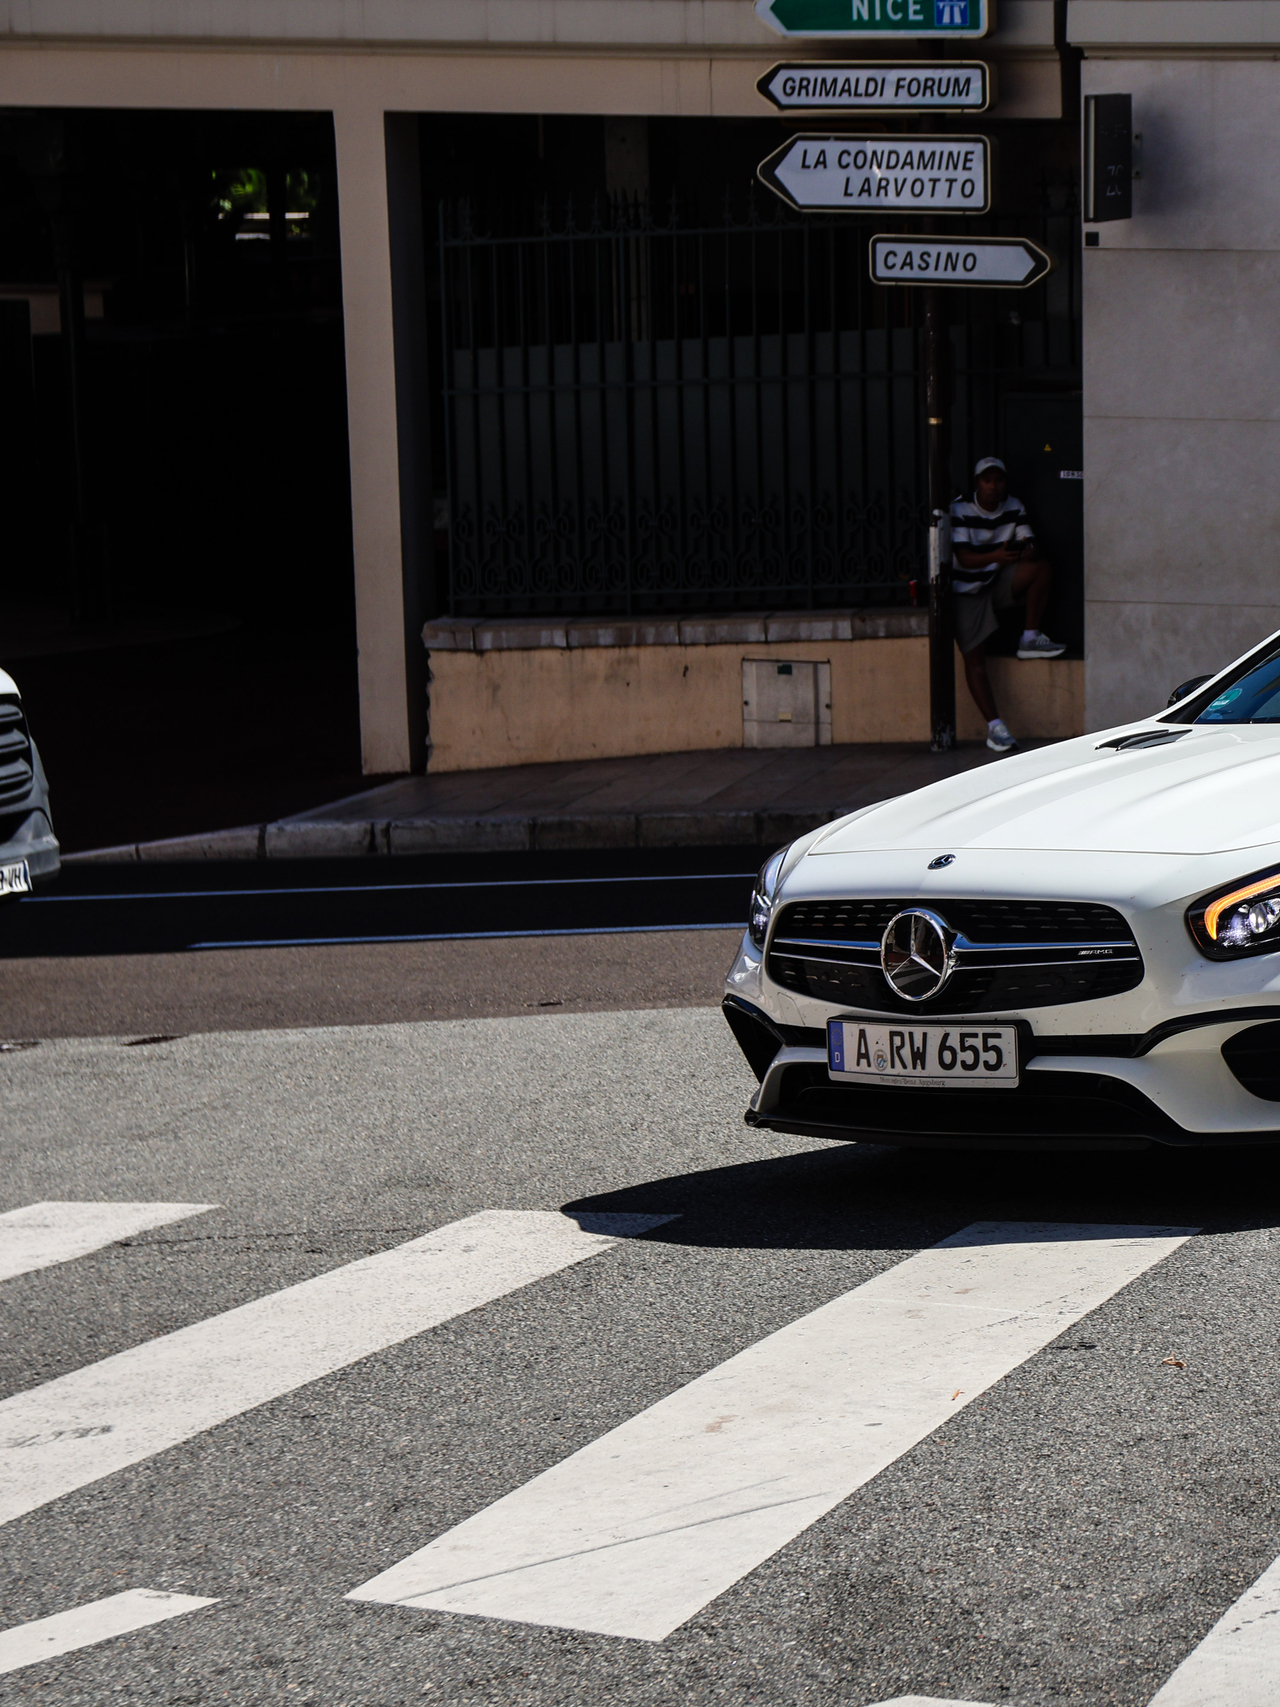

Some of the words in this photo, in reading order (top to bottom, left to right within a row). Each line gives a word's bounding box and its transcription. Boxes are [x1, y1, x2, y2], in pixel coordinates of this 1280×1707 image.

[851, 0, 924, 21] NICE
[782, 77, 886, 98] GRIMALDI
[893, 77, 971, 98] FORUM
[801, 149, 828, 169] LA
[837, 149, 975, 171] CONDAMINE
[843, 177, 976, 198] LARVOTTO
[883, 250, 977, 272] CASINO
[856, 1028, 871, 1067] A
[889, 1030, 927, 1070] RW
[938, 1032, 1003, 1071] 655
